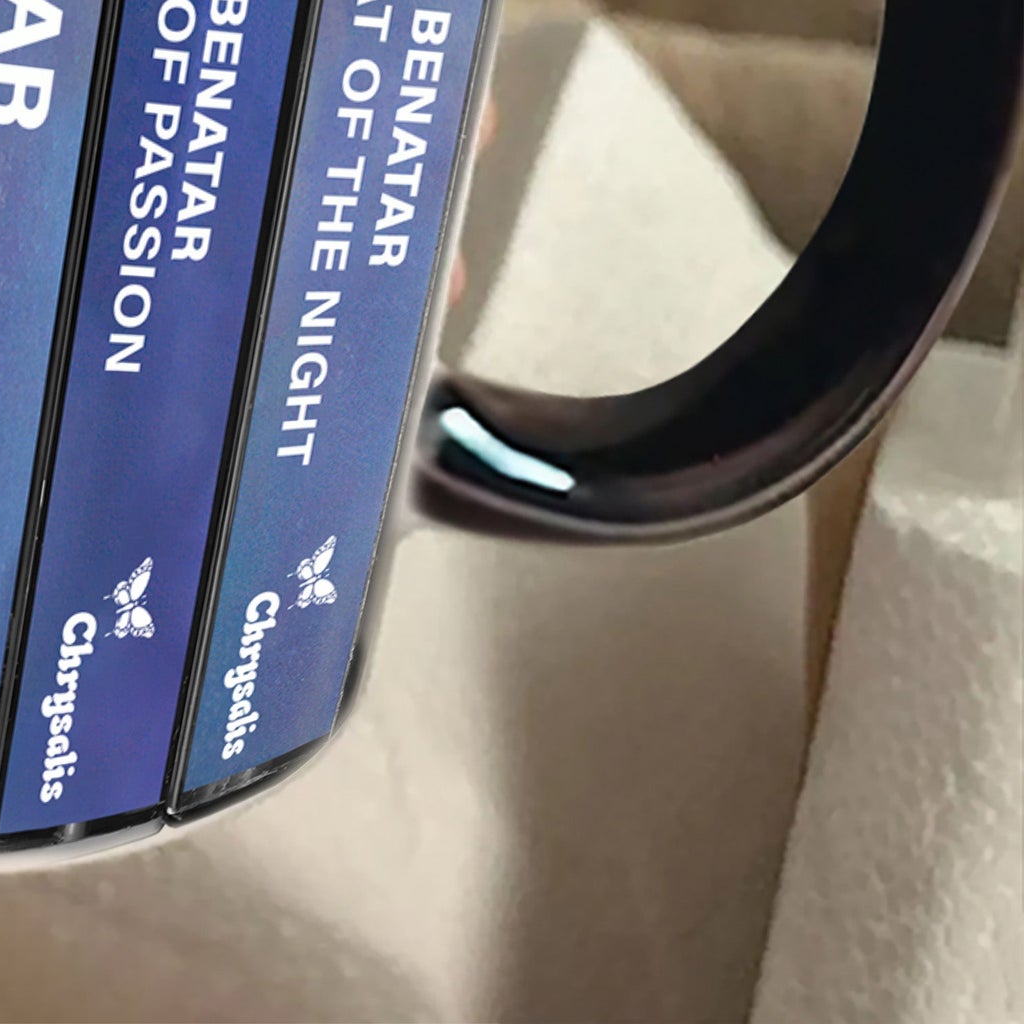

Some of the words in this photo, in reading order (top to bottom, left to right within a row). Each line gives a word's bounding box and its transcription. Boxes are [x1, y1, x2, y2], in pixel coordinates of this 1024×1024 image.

[336, 58, 382, 142] OF
[367, 9, 453, 269] BENATAR
[105, 102, 182, 373] PASSION
[309, 155, 367, 273] THE
[275, 291, 342, 466] NIGHT
[40, 611, 98, 803] Chrysalis
[220, 590, 281, 761] Chrysalis
